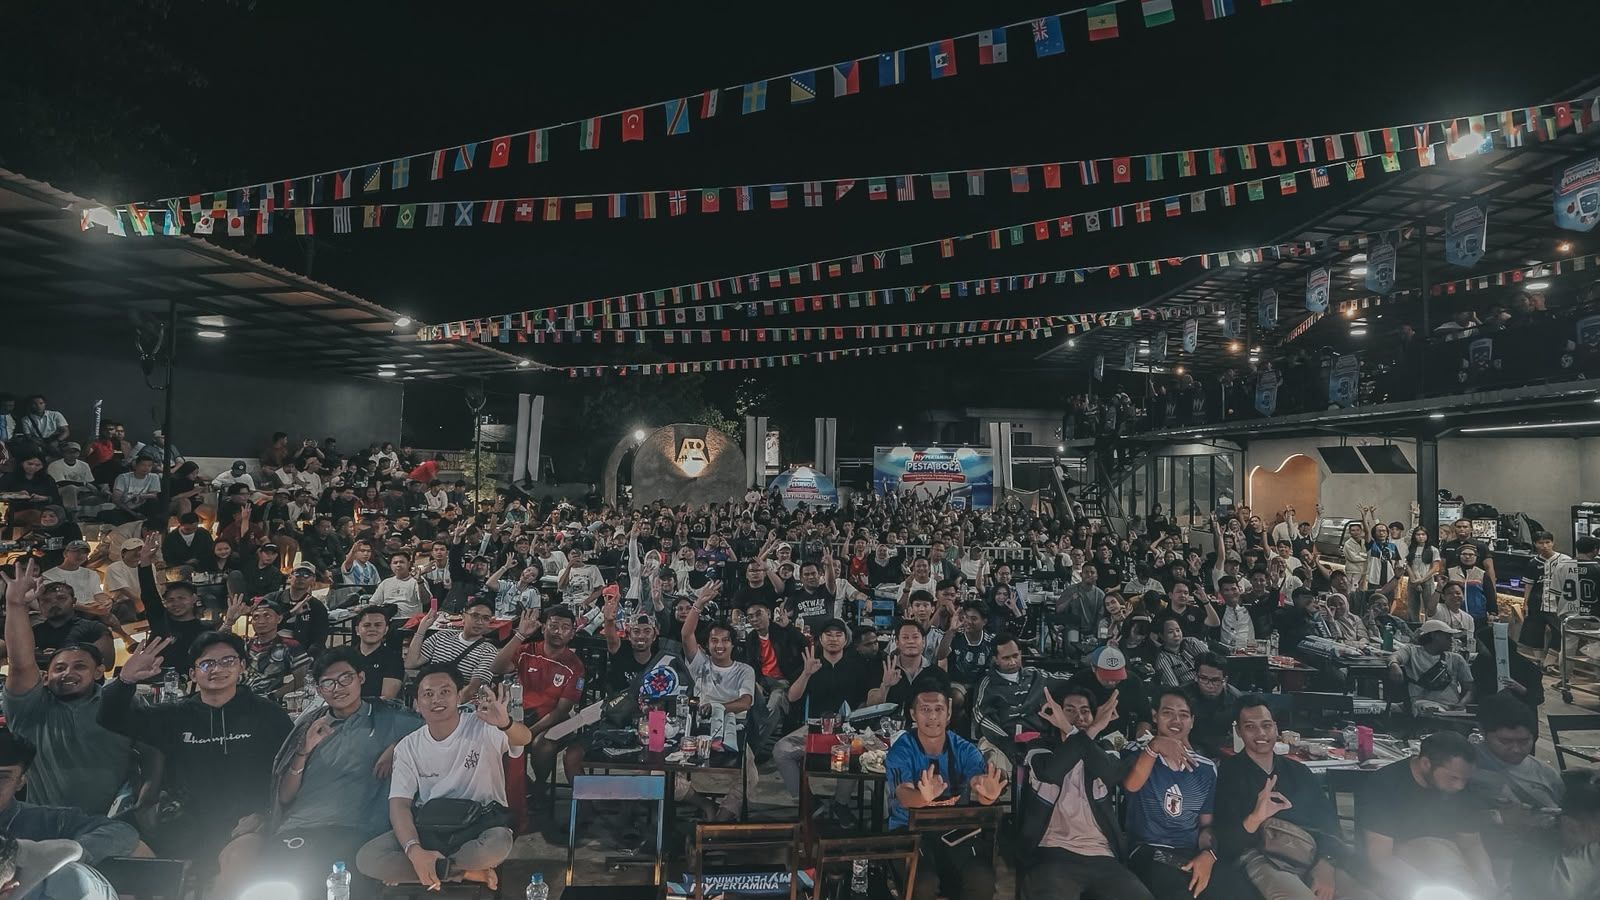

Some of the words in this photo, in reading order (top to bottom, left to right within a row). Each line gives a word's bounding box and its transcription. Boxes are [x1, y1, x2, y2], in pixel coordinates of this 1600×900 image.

[907, 462, 933, 471] PESTA
[936, 462, 961, 472] BOLA
[1563, 579, 1598, 603] 90
